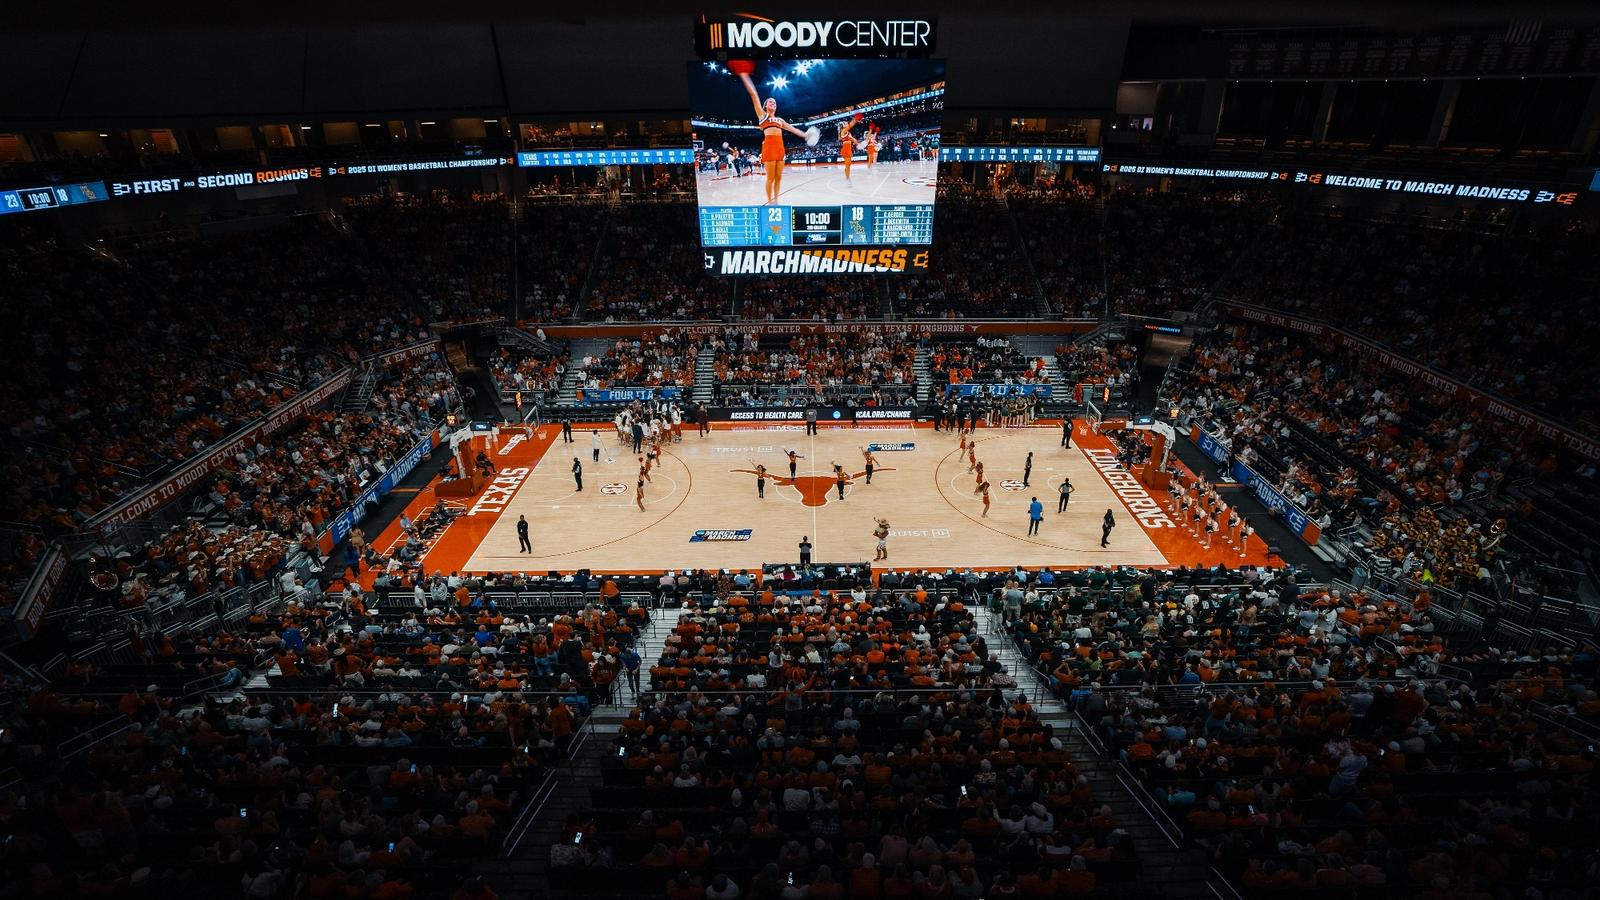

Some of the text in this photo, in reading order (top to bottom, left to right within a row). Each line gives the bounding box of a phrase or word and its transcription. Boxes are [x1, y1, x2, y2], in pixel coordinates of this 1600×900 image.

[727, 20, 931, 48] MOODY CENTER
[348, 166, 367, 174] 2025
[377, 163, 408, 172] WOMEN'S
[408, 161, 449, 171] BASKETBALL
[449, 159, 498, 168] CHAMPIONSHIP
[1119, 165, 1136, 173] 2025
[1145, 166, 1175, 175] WOMEN'S
[1174, 168, 1215, 177] BASKETBALL
[1215, 169, 1269, 179] CHAMPIONSHIP
[133, 178, 182, 194] FIRST
[197, 172, 254, 189] SECOND
[256, 169, 309, 183] ROUNDS
[1324, 174, 1530, 202] WELCOME TO MARCH MADNESS
[4, 194, 19, 208] 23
[28, 192, 51, 205] 10:00
[56, 188, 69, 202] 18
[768, 207, 782, 222] 23
[804, 212, 831, 225] 10:00
[851, 206, 864, 221] 18
[679, 325, 720, 334] WELCOME
[736, 325, 765, 333] MOODY
[767, 325, 801, 333] CENTER
[824, 325, 849, 333] HOME
[850, 325, 863, 333] OF
[864, 325, 882, 333] THE
[885, 325, 913, 333] TEXAS
[1242, 309, 1268, 325] HOOK
[1289, 319, 1324, 335] HORNS
[1379, 351, 1390, 364] TO
[1390, 357, 1420, 378] MOODY
[1420, 371, 1459, 396] CENTER
[608, 390, 634, 400] FOUR
[261, 416, 283, 436] HOME
[288, 404, 303, 419] THE
[730, 411, 804, 420] ACCESS TO HEALTH CARE
[1487, 400, 1519, 423] HOME
[1518, 415, 1536, 429] OF
[1536, 421, 1561, 442] THE
[159, 483, 176, 500] TO
[175, 462, 210, 491] MOODY
[210, 440, 248, 469] CENTER
[466, 467, 530, 516] TEXAS
[1083, 448, 1177, 529] LONGHORNS
